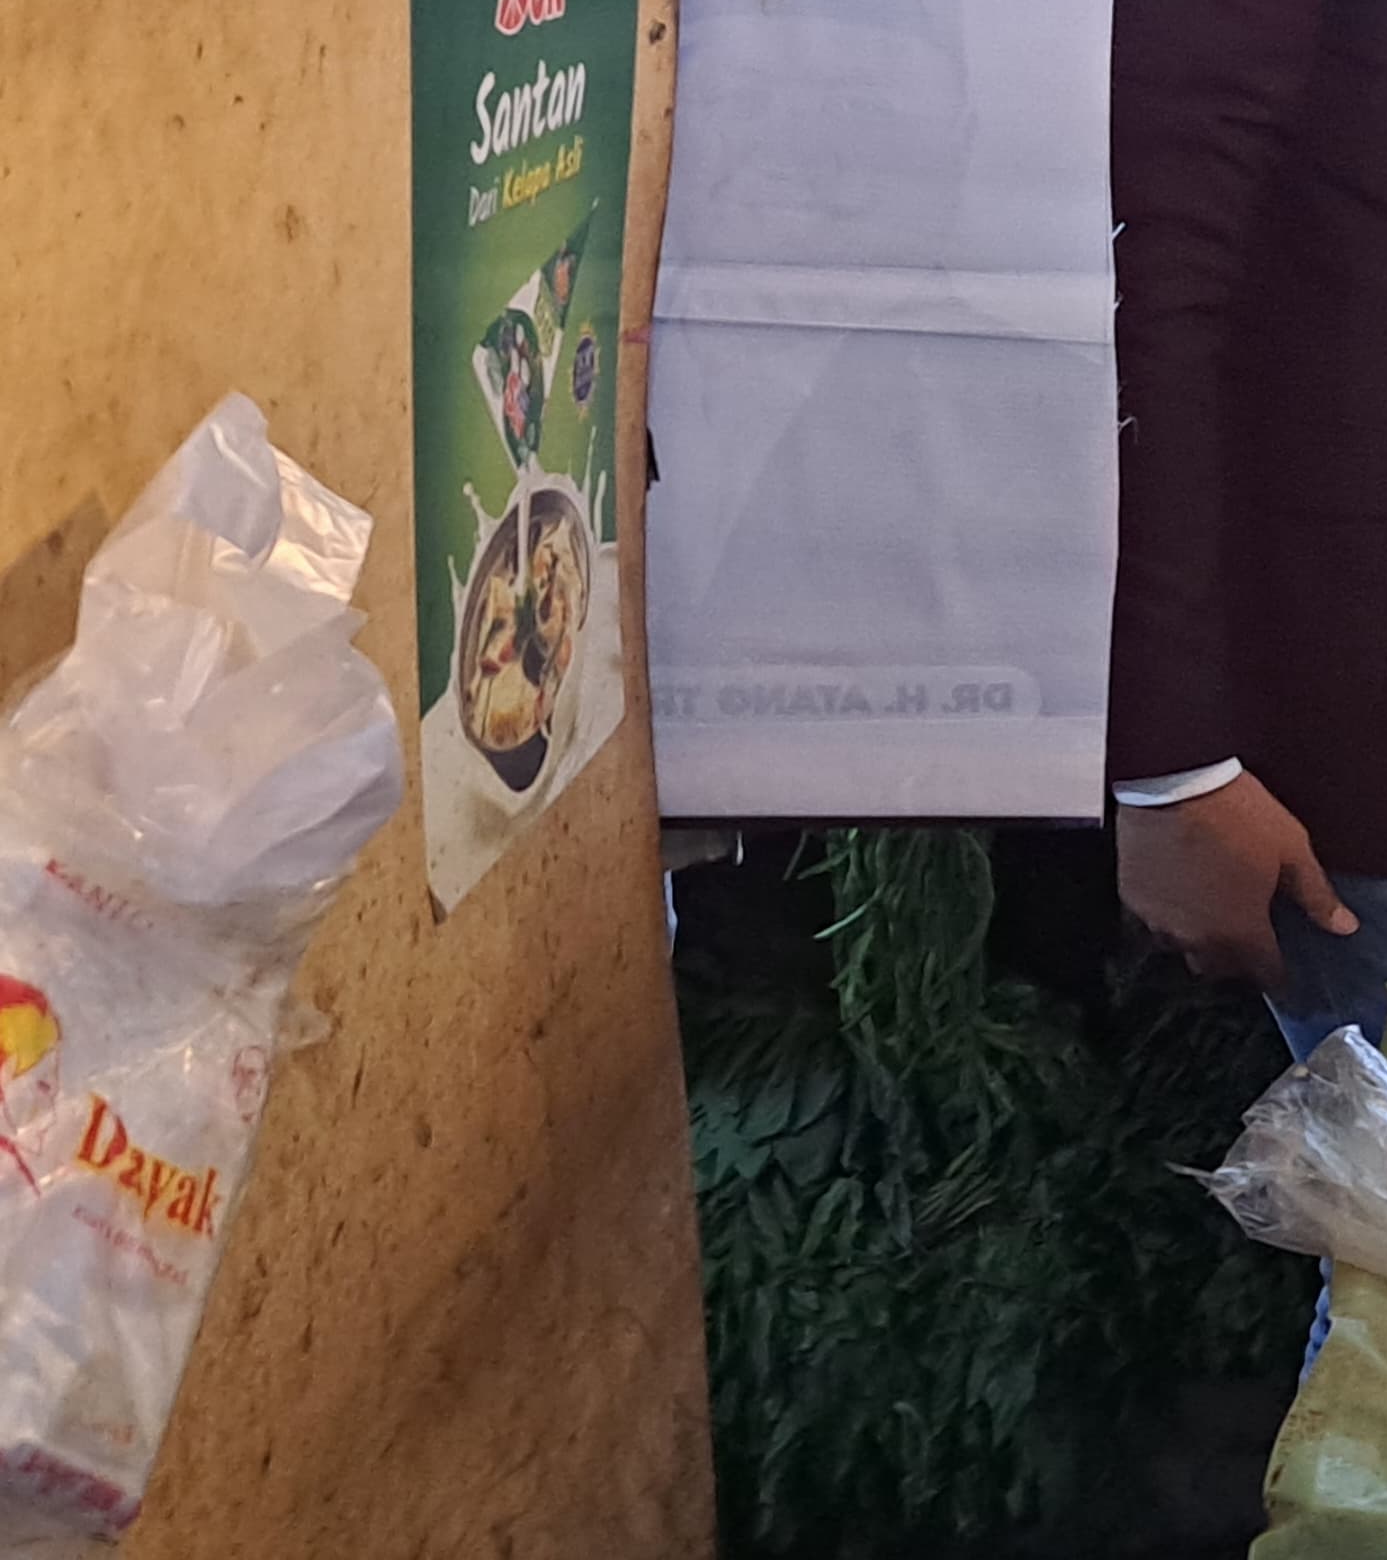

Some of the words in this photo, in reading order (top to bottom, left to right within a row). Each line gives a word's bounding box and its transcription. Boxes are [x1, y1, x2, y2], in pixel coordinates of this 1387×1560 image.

[470, 58, 587, 166] Santan
[468, 176, 499, 228] Dari
[502, 157, 551, 211] Kelapa
[554, 135, 584, 182] Asli
[75, 1090, 223, 1239] Dayak
